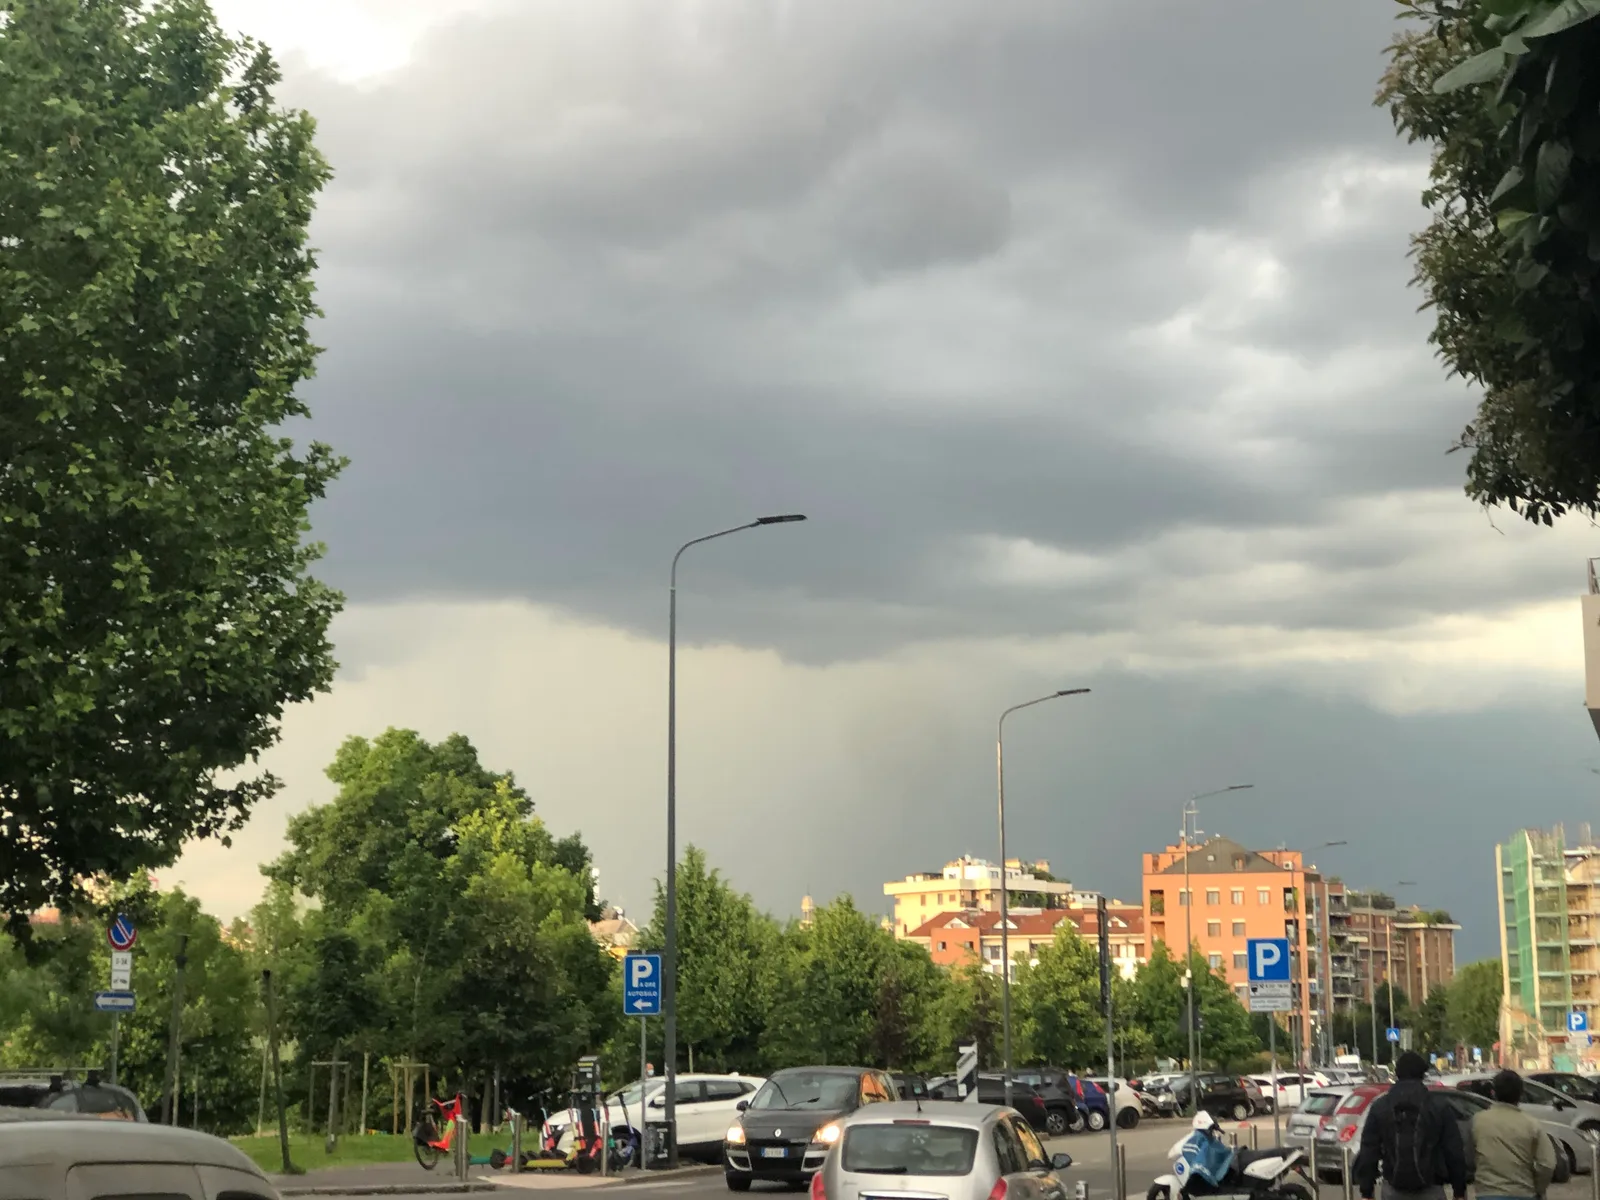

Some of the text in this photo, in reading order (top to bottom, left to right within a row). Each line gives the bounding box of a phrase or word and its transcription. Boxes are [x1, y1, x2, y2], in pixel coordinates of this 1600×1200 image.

[632, 959, 653, 988] P
[1255, 942, 1281, 977] P
[1571, 1013, 1583, 1031] P
